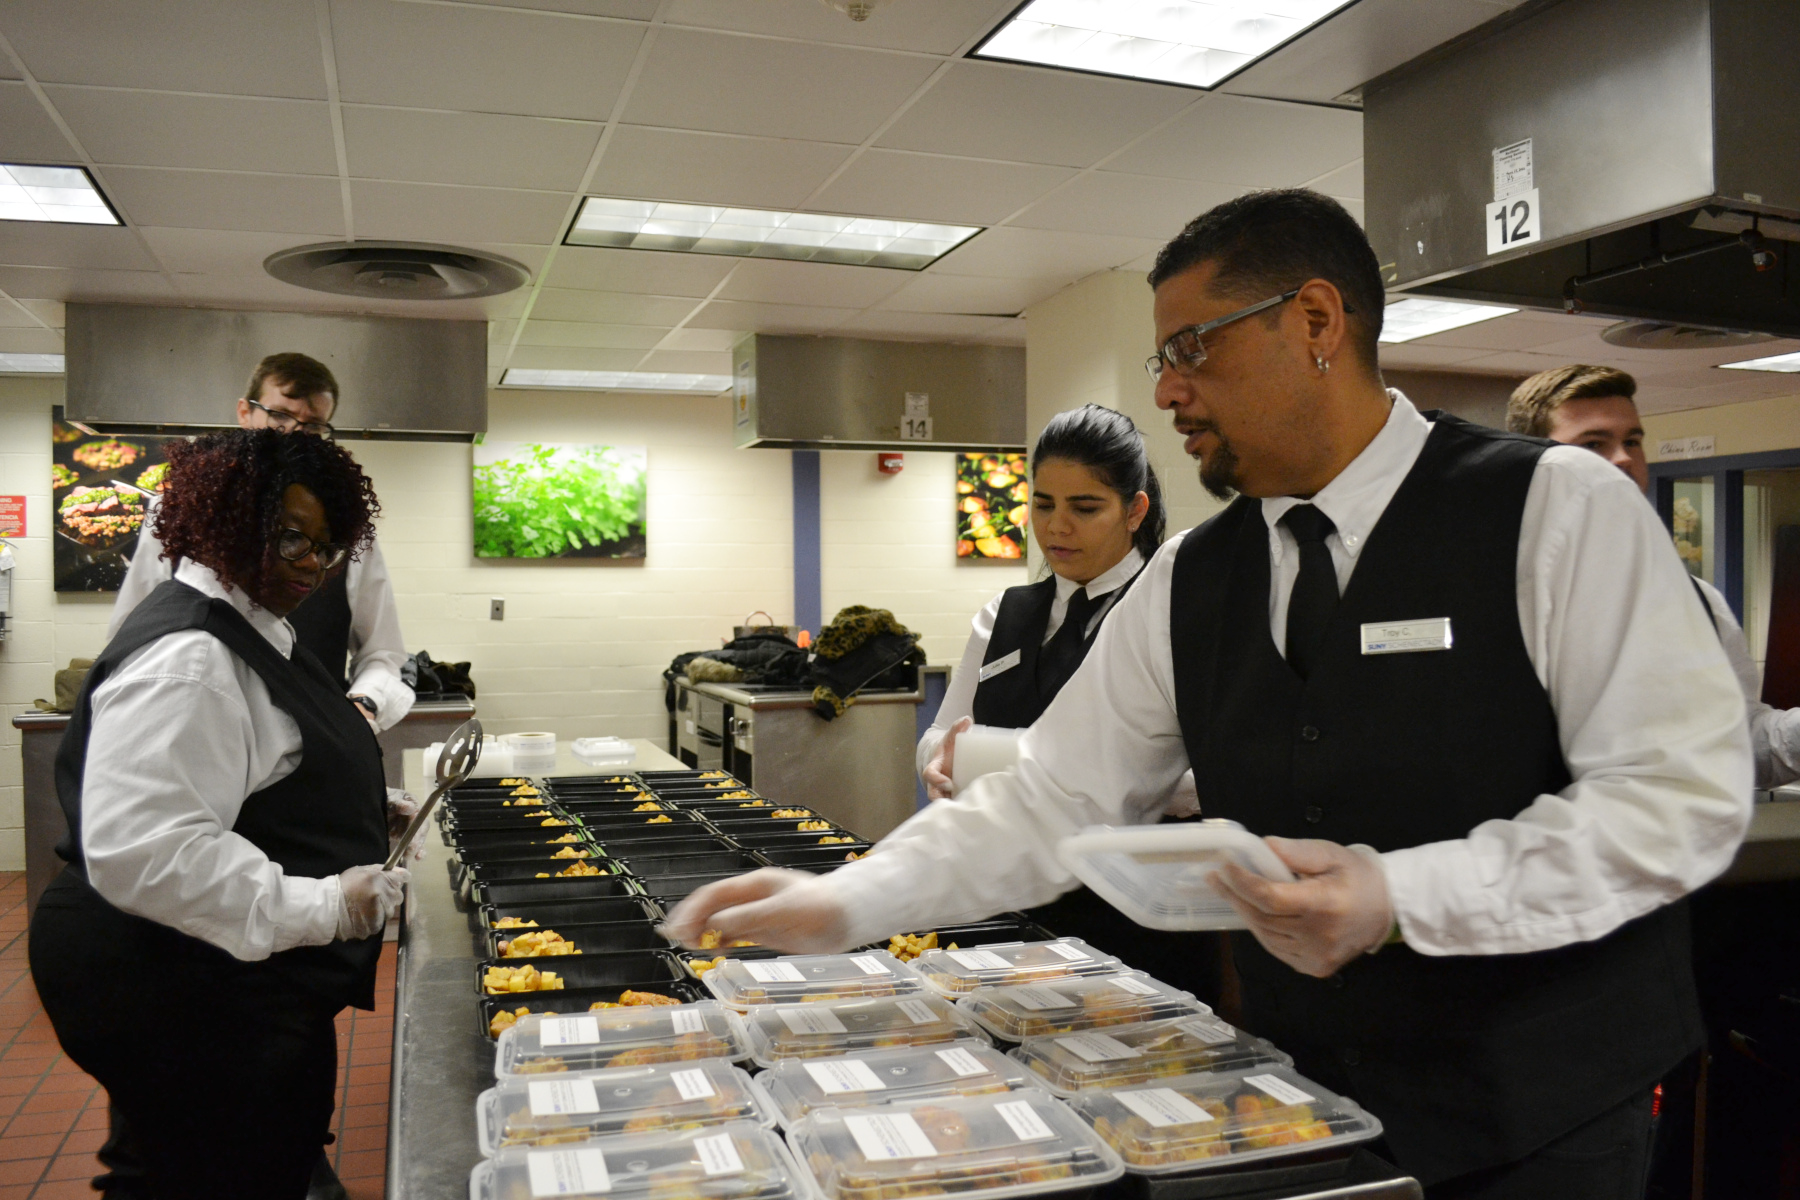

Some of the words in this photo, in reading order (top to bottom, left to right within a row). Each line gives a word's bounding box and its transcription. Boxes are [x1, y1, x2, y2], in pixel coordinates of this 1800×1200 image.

[1495, 200, 1530, 245] 12
[905, 419, 927, 438] 14
[1381, 628, 1400, 638] Troy
[1367, 643, 1387, 651] SUNY
